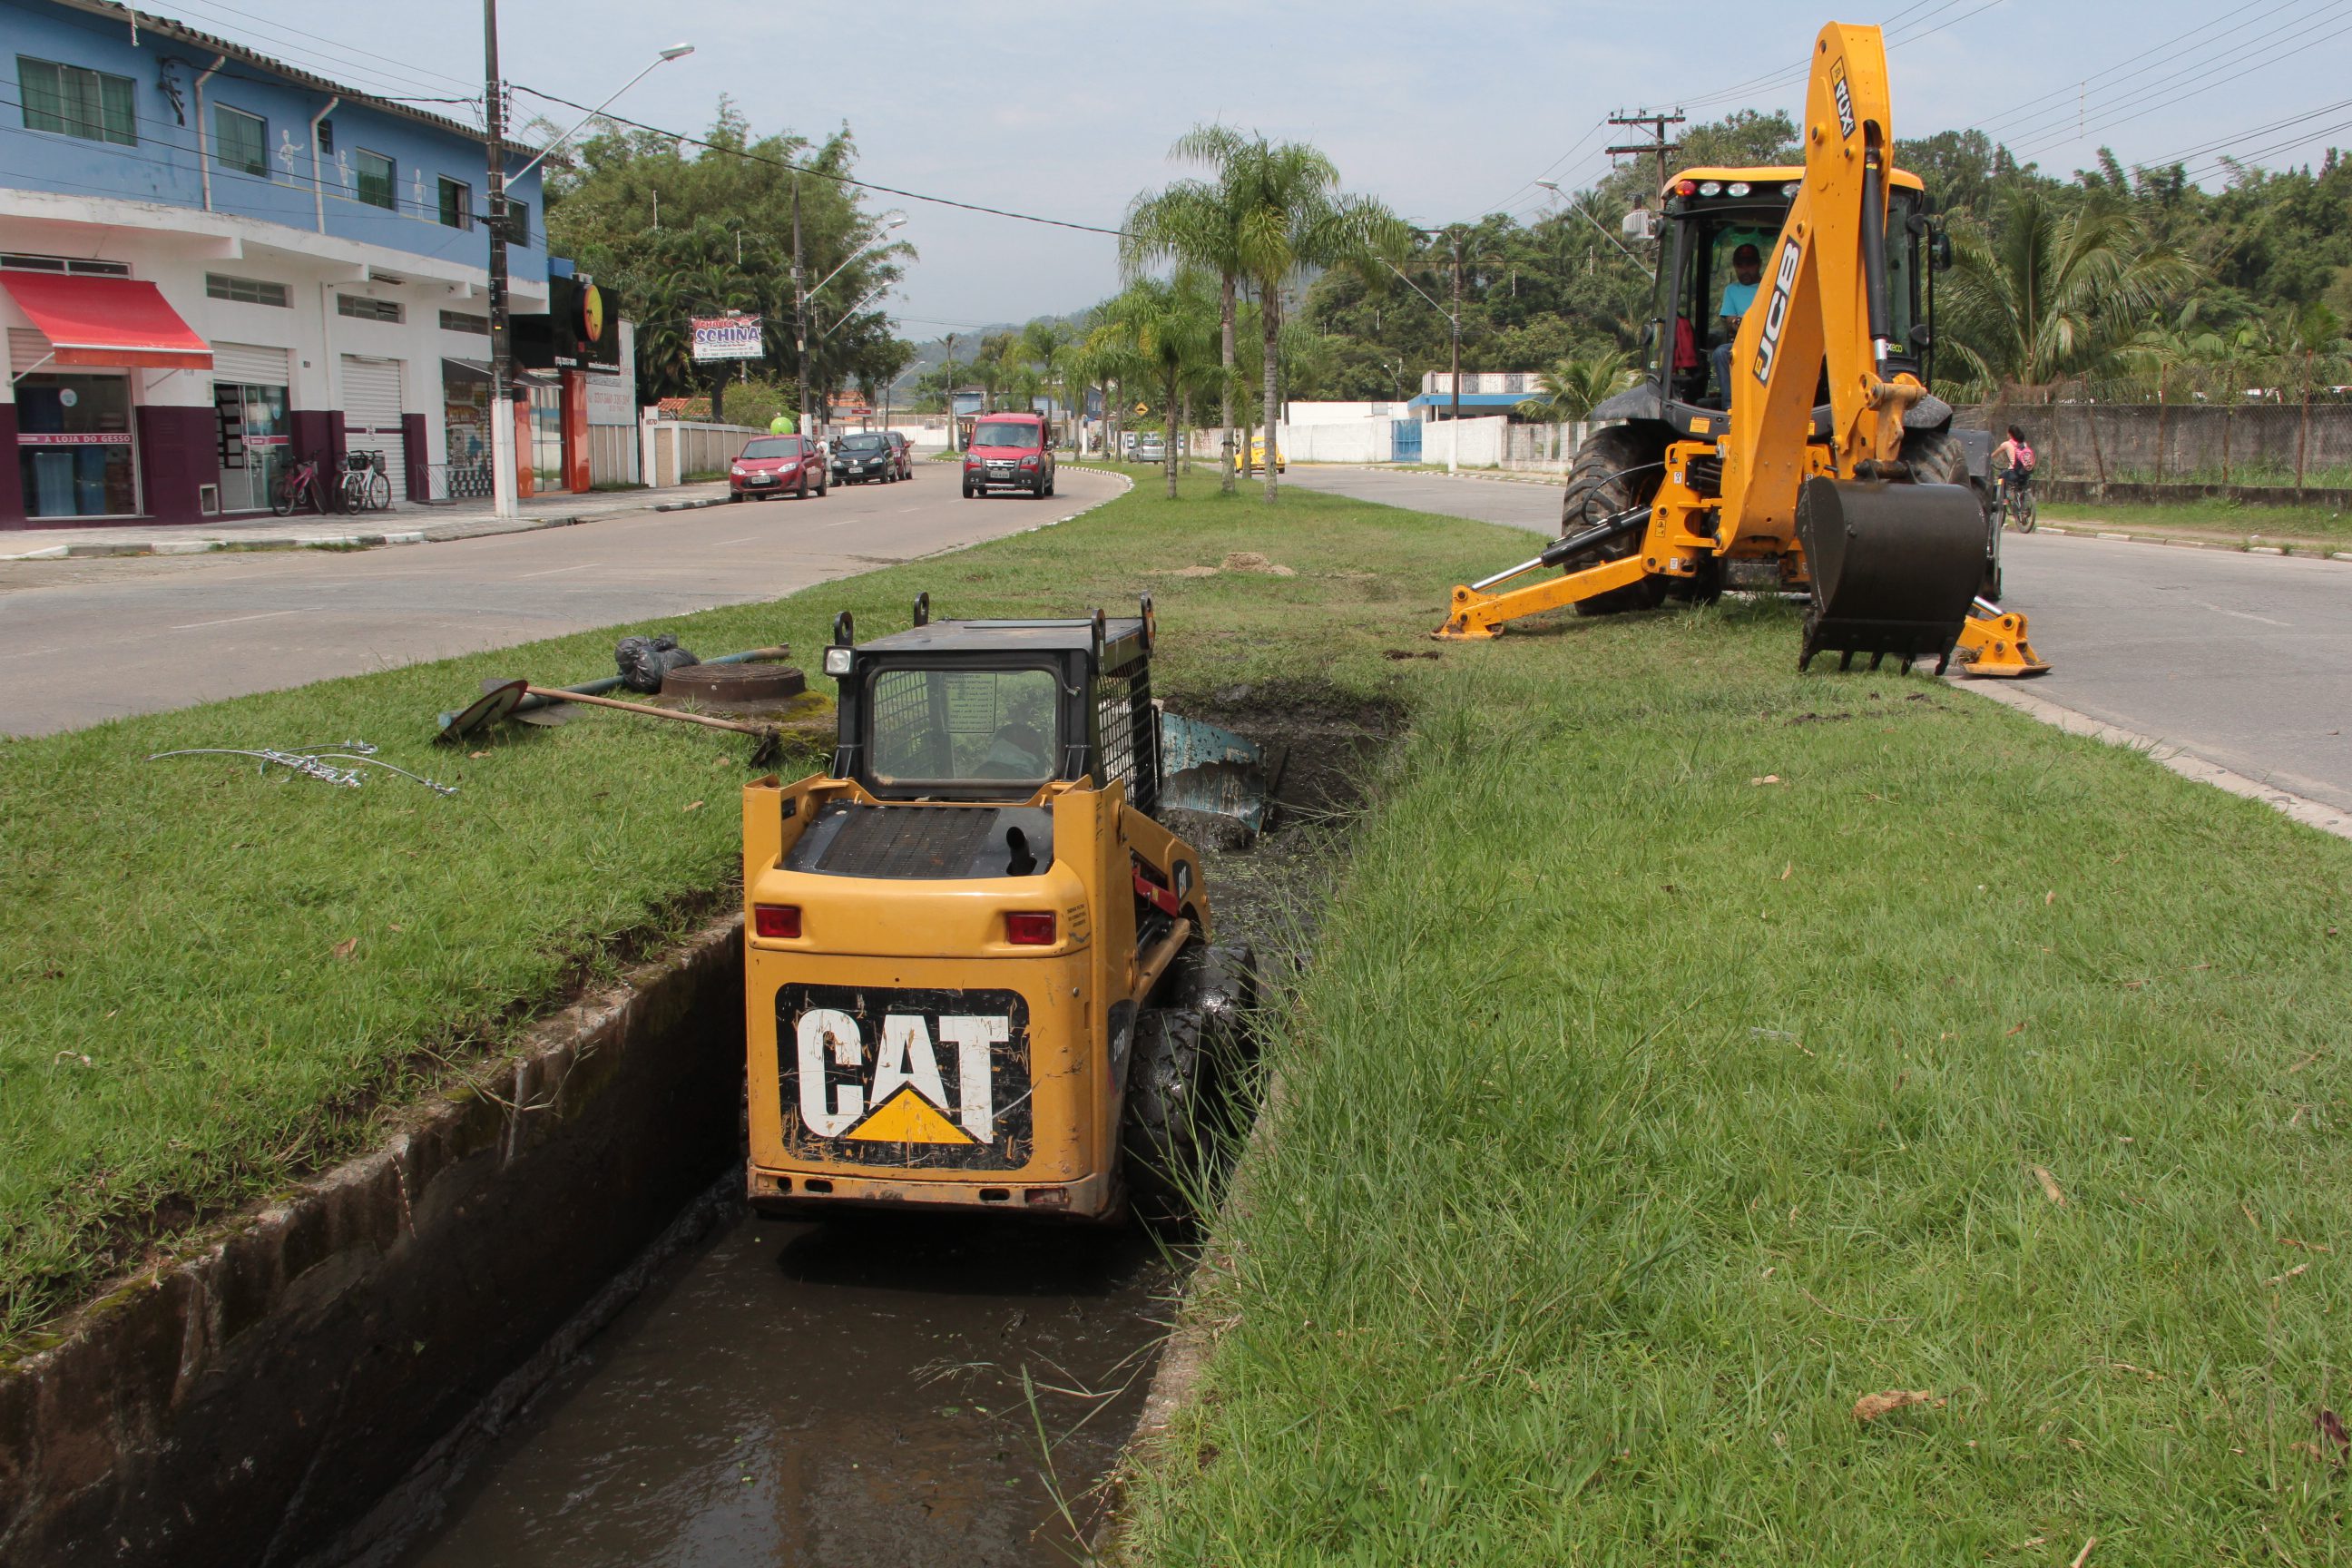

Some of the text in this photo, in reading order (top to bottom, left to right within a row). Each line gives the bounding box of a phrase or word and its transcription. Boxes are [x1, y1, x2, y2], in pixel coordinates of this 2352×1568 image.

[696, 327, 760, 344] SCHINA
[1759, 242, 1799, 381] JCB
[798, 1009, 1009, 1144] CAT
